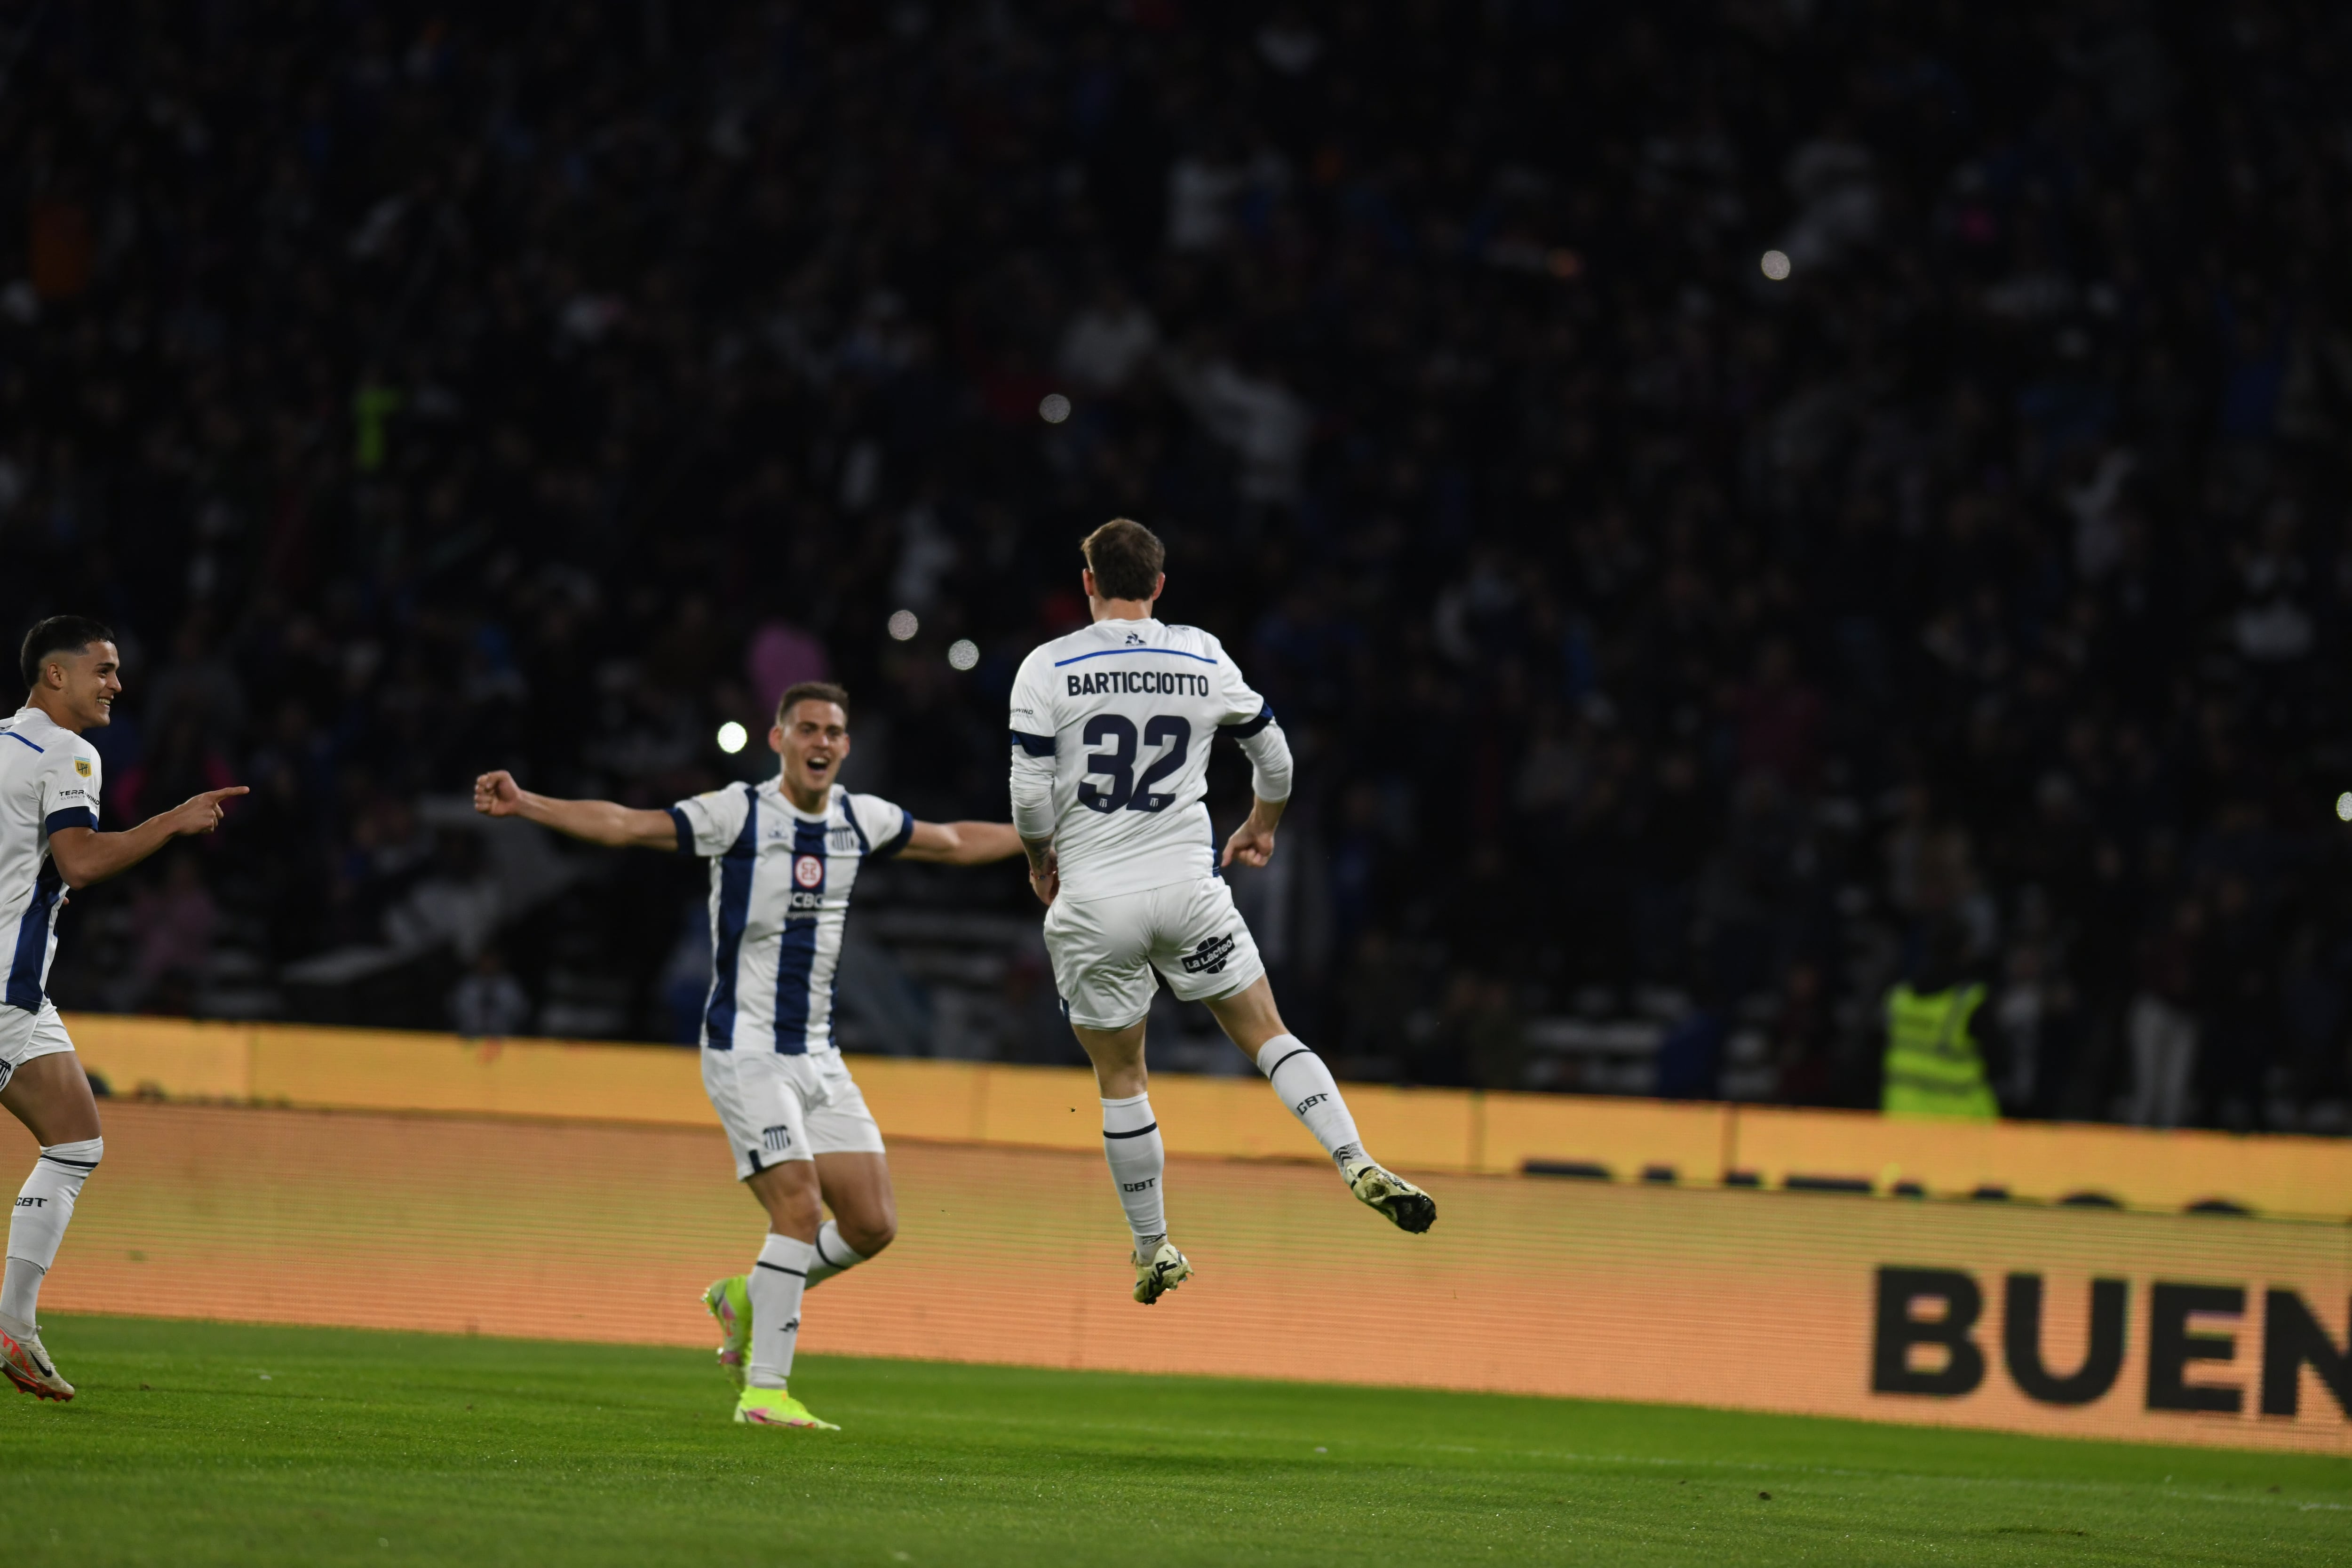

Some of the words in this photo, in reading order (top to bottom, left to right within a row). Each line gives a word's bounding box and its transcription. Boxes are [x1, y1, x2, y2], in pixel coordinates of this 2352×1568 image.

[1067, 671, 1209, 697] BARTICCIOTTO
[1078, 714, 1192, 814] 32
[1186, 960, 1201, 969] La
[1200, 939, 1232, 965] Lácteo
[1874, 1266, 2352, 1417] BUEN
